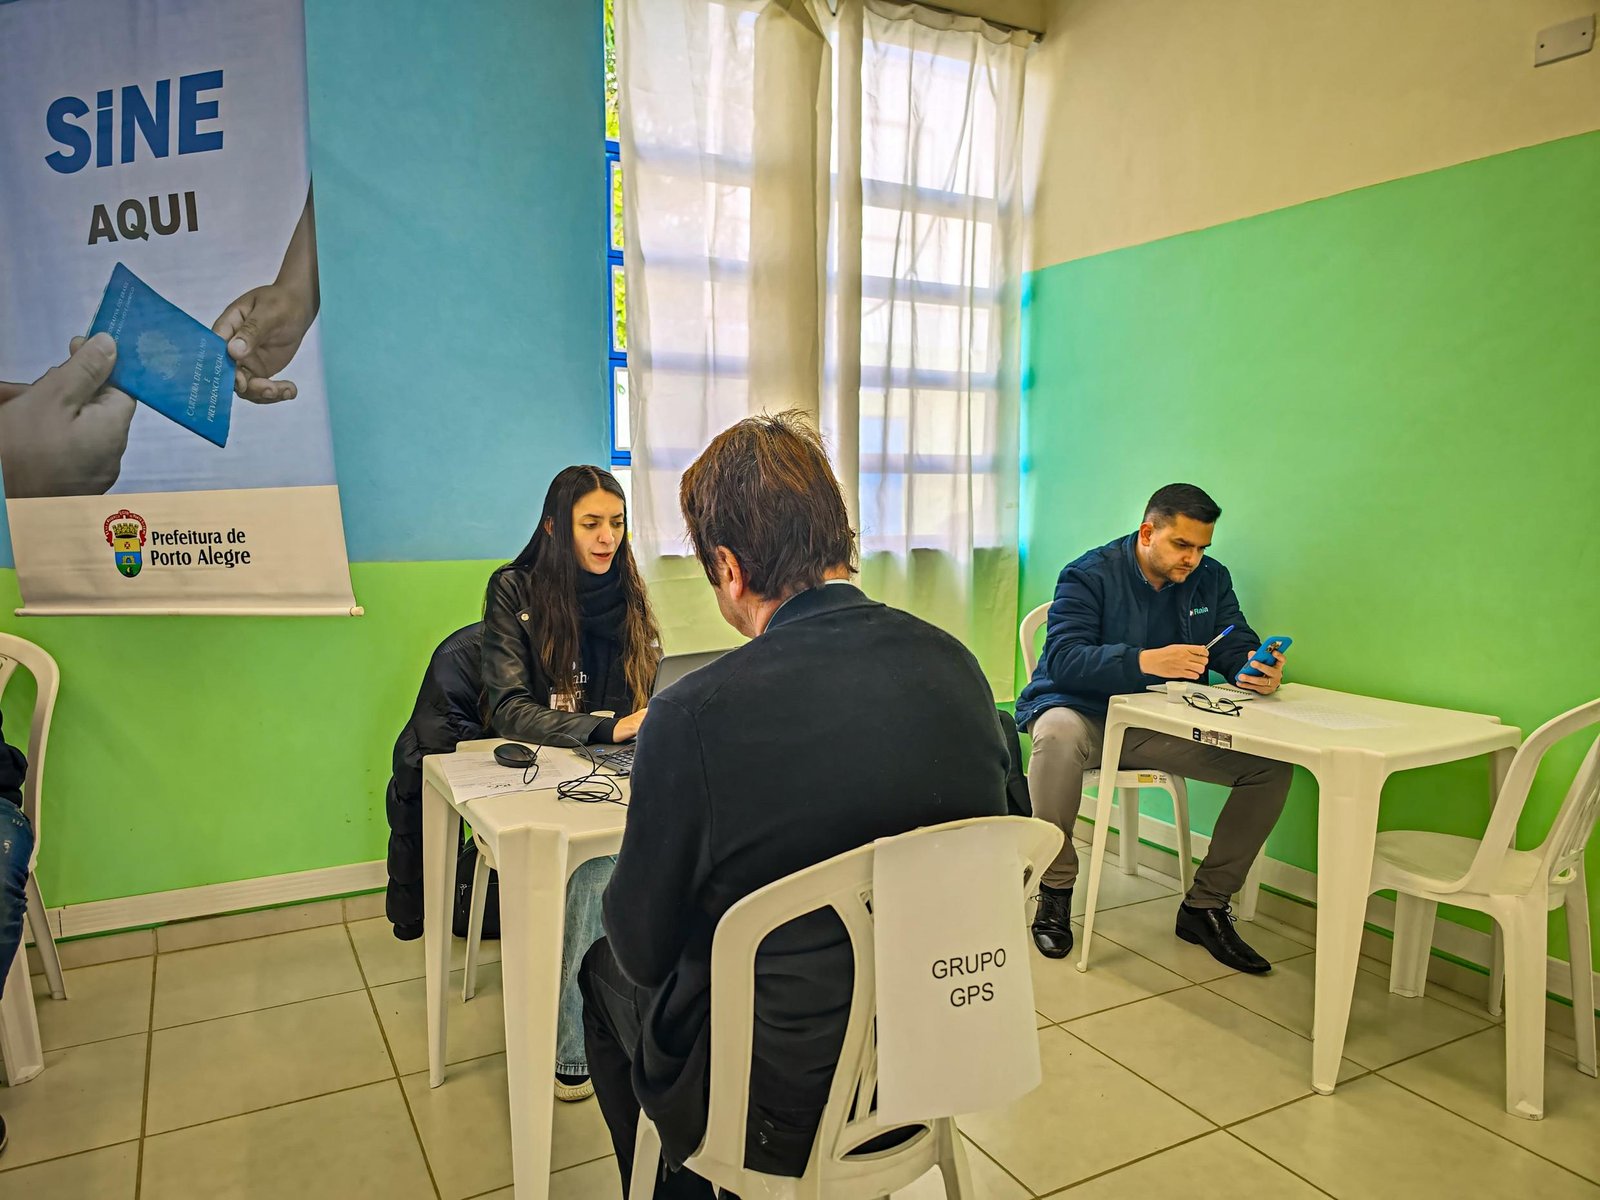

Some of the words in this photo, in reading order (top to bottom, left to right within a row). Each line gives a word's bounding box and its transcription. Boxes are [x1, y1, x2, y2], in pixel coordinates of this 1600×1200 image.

[88, 191, 199, 245] AQUI
[151, 529, 222, 546] Prefeitura
[227, 528, 246, 544] de
[150, 550, 192, 566] Porto
[197, 545, 251, 568] Alegre
[931, 948, 1006, 979] GRUPO
[950, 982, 994, 1007] GPS
